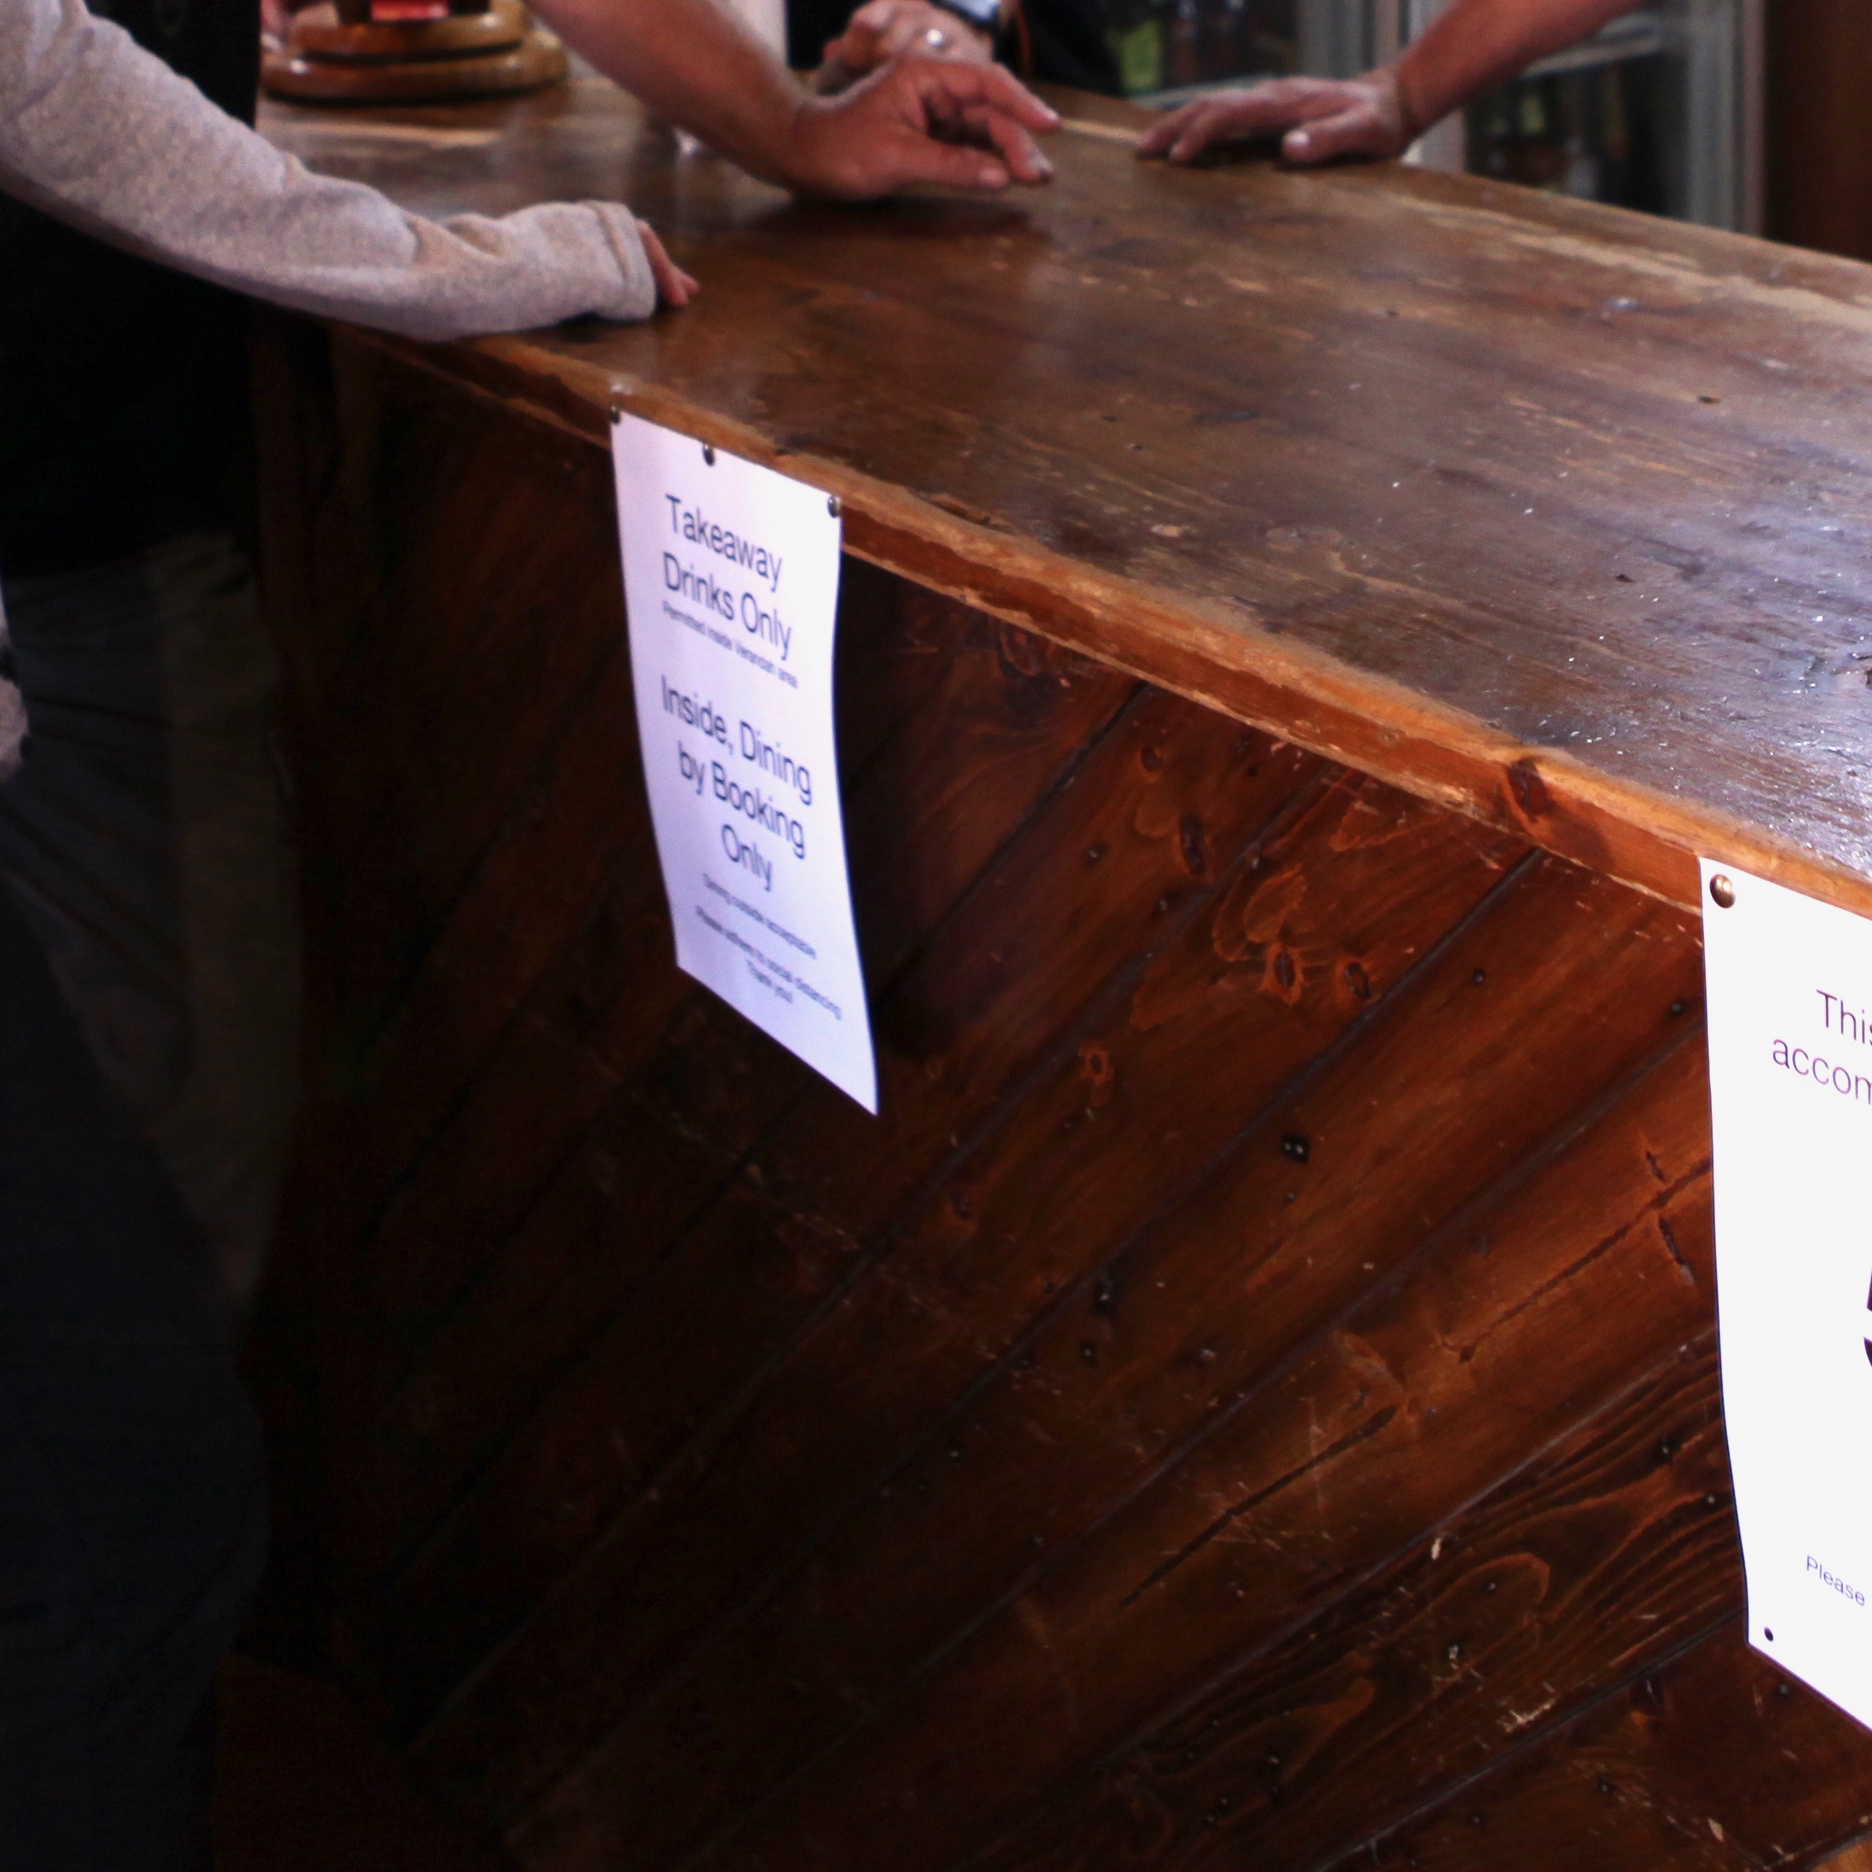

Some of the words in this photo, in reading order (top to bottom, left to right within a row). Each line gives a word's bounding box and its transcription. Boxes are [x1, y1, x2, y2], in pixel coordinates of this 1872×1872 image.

[665, 493, 783, 592] Takeaway
[663, 551, 735, 622] Drinks
[741, 592, 793, 661] Only
[660, 674, 735, 757] Inside,
[740, 720, 813, 806] Dining
[678, 740, 706, 796] by
[711, 760, 806, 860] Booking
[721, 824, 773, 892] Only
[1805, 1554, 1866, 1608] Please
